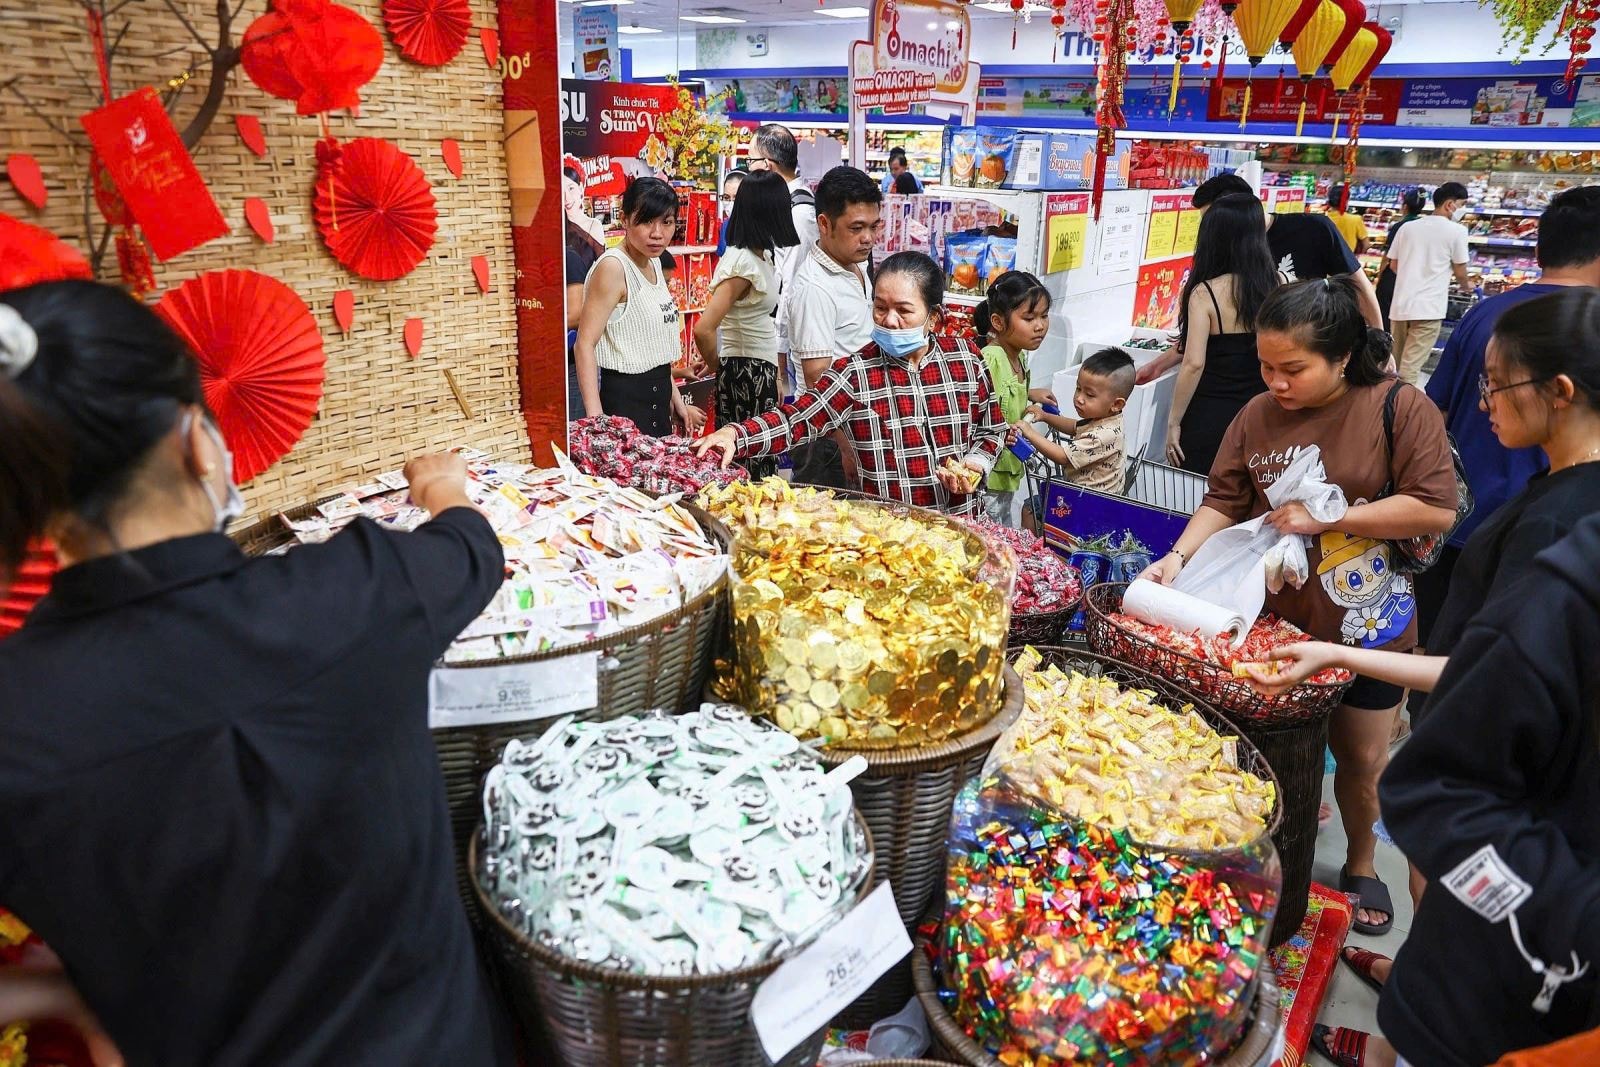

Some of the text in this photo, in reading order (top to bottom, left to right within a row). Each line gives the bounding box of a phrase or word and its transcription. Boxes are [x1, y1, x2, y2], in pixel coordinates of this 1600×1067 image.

[887, 30, 950, 68] Omachi
[855, 79, 875, 92] MANG
[613, 96, 660, 109] Kính chúc Tết
[600, 109, 638, 134] Sum
[1050, 507, 1072, 518] Tiger
